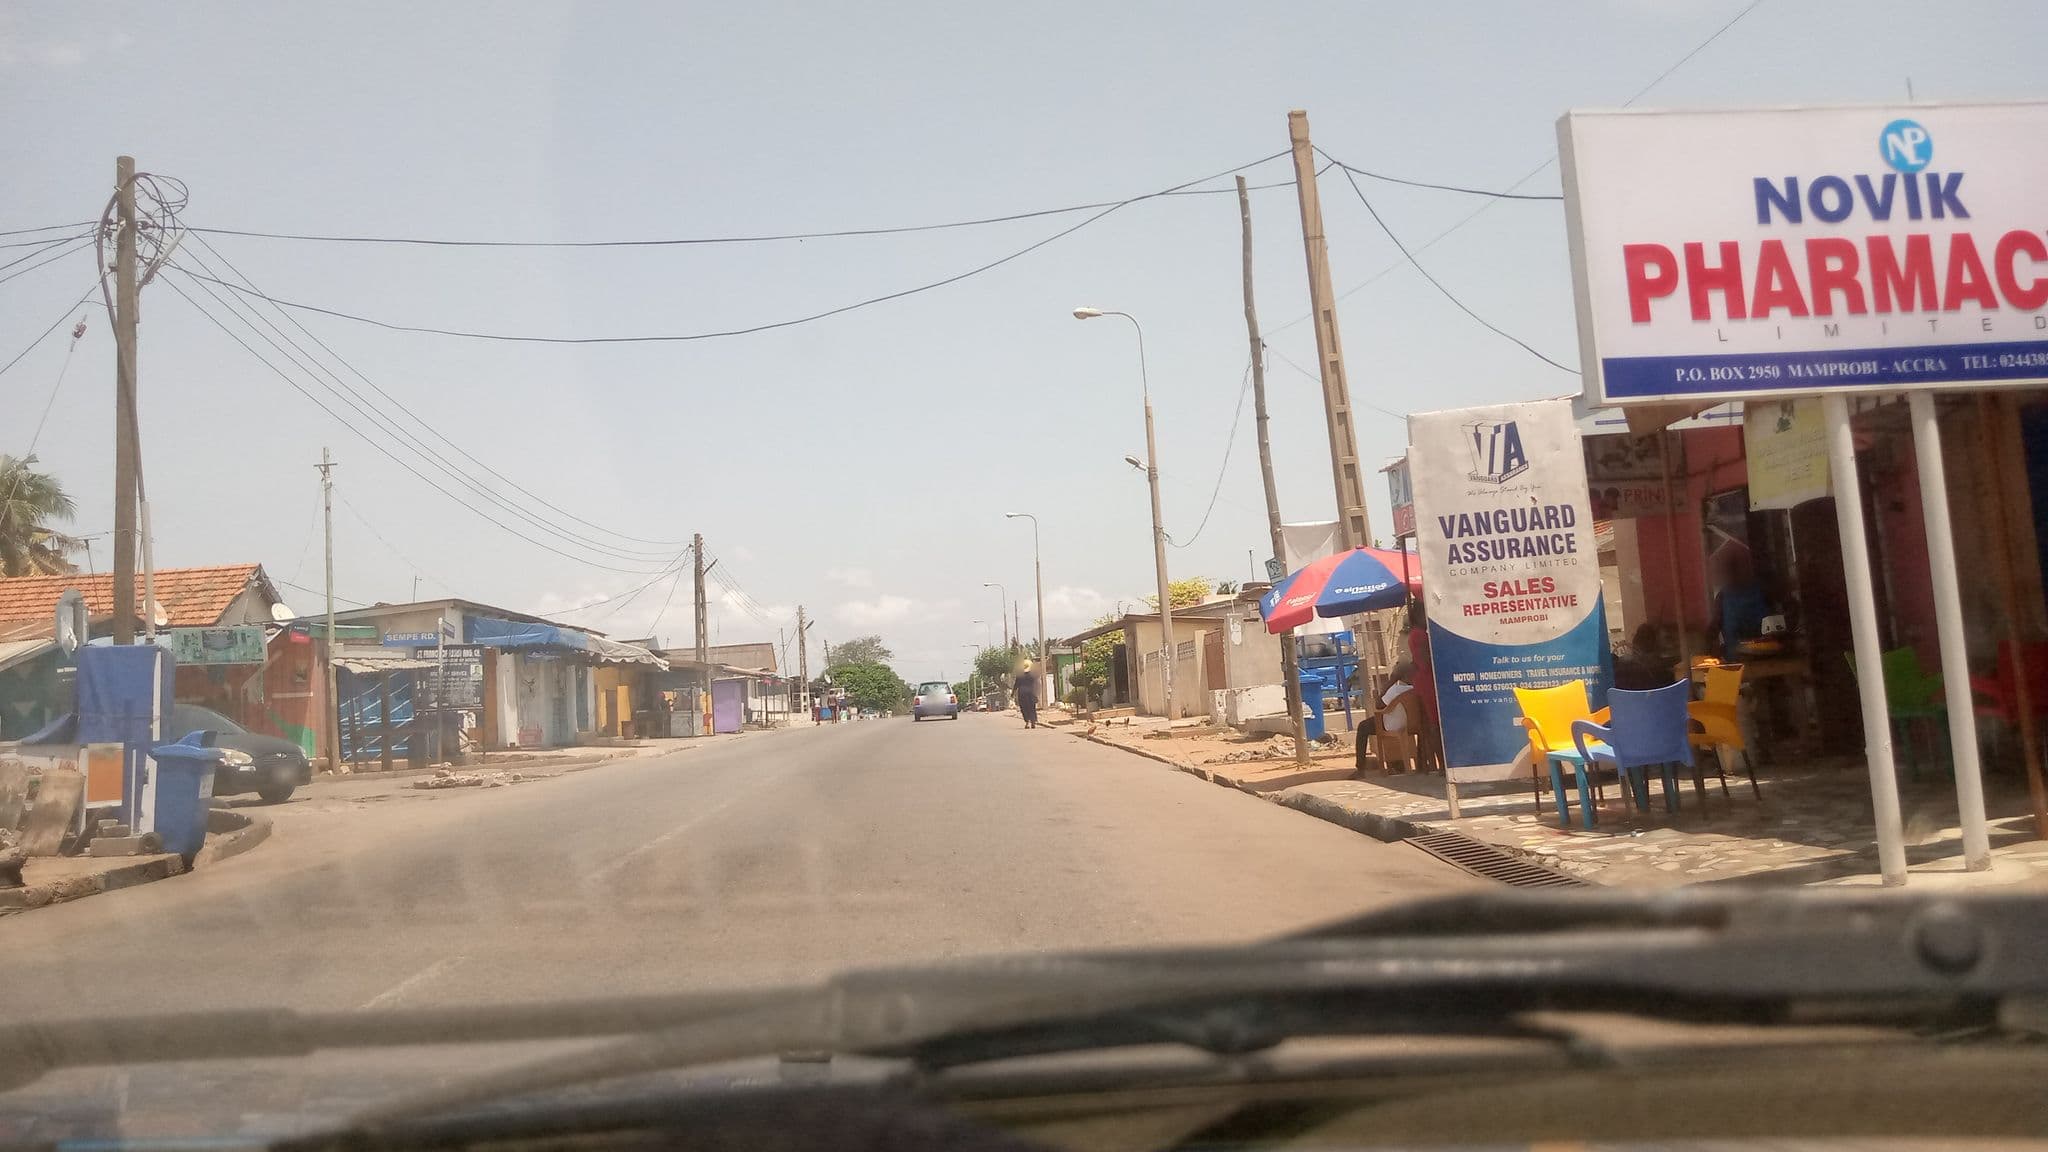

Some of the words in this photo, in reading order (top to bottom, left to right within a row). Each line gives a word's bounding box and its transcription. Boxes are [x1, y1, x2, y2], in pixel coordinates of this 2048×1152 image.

[1753, 172, 1971, 224] NOVIK
[1623, 229, 2048, 323] PHARMAC
[1717, 316, 2047, 342] LIMITED
[1675, 365, 1706, 382] P.O.
[1709, 364, 1745, 381] BOX
[1748, 363, 1781, 380] 2950
[1788, 359, 1879, 378] MAMPROBI
[1891, 358, 1947, 375] ACCRA
[1961, 355, 1997, 370] TEL:
[1438, 504, 1576, 539] VANGUARD
[1448, 533, 1577, 565] ASSURANCE
[1450, 563, 1515, 576] COMPANY
[1525, 558, 1578, 570] LIMITED
[1483, 576, 1555, 598] SALES
[1463, 594, 1578, 617] REPRESENTATIVE
[1500, 615, 1549, 625] MAMPROBI
[386, 633, 418, 641] SEMPE
[421, 632, 436, 640] RD.
[1492, 656, 1509, 665] Talk
[1511, 655, 1520, 663] to
[1521, 655, 1532, 663] us
[1533, 654, 1545, 662] for
[1547, 654, 1566, 664] your
[1453, 672, 1476, 682] MOTOR
[1479, 670, 1522, 680] HOMEOWNERS
[1526, 668, 1548, 678] TRAVEL
[1459, 685, 1475, 693] TEL:
[1475, 683, 1493, 692] 0302
